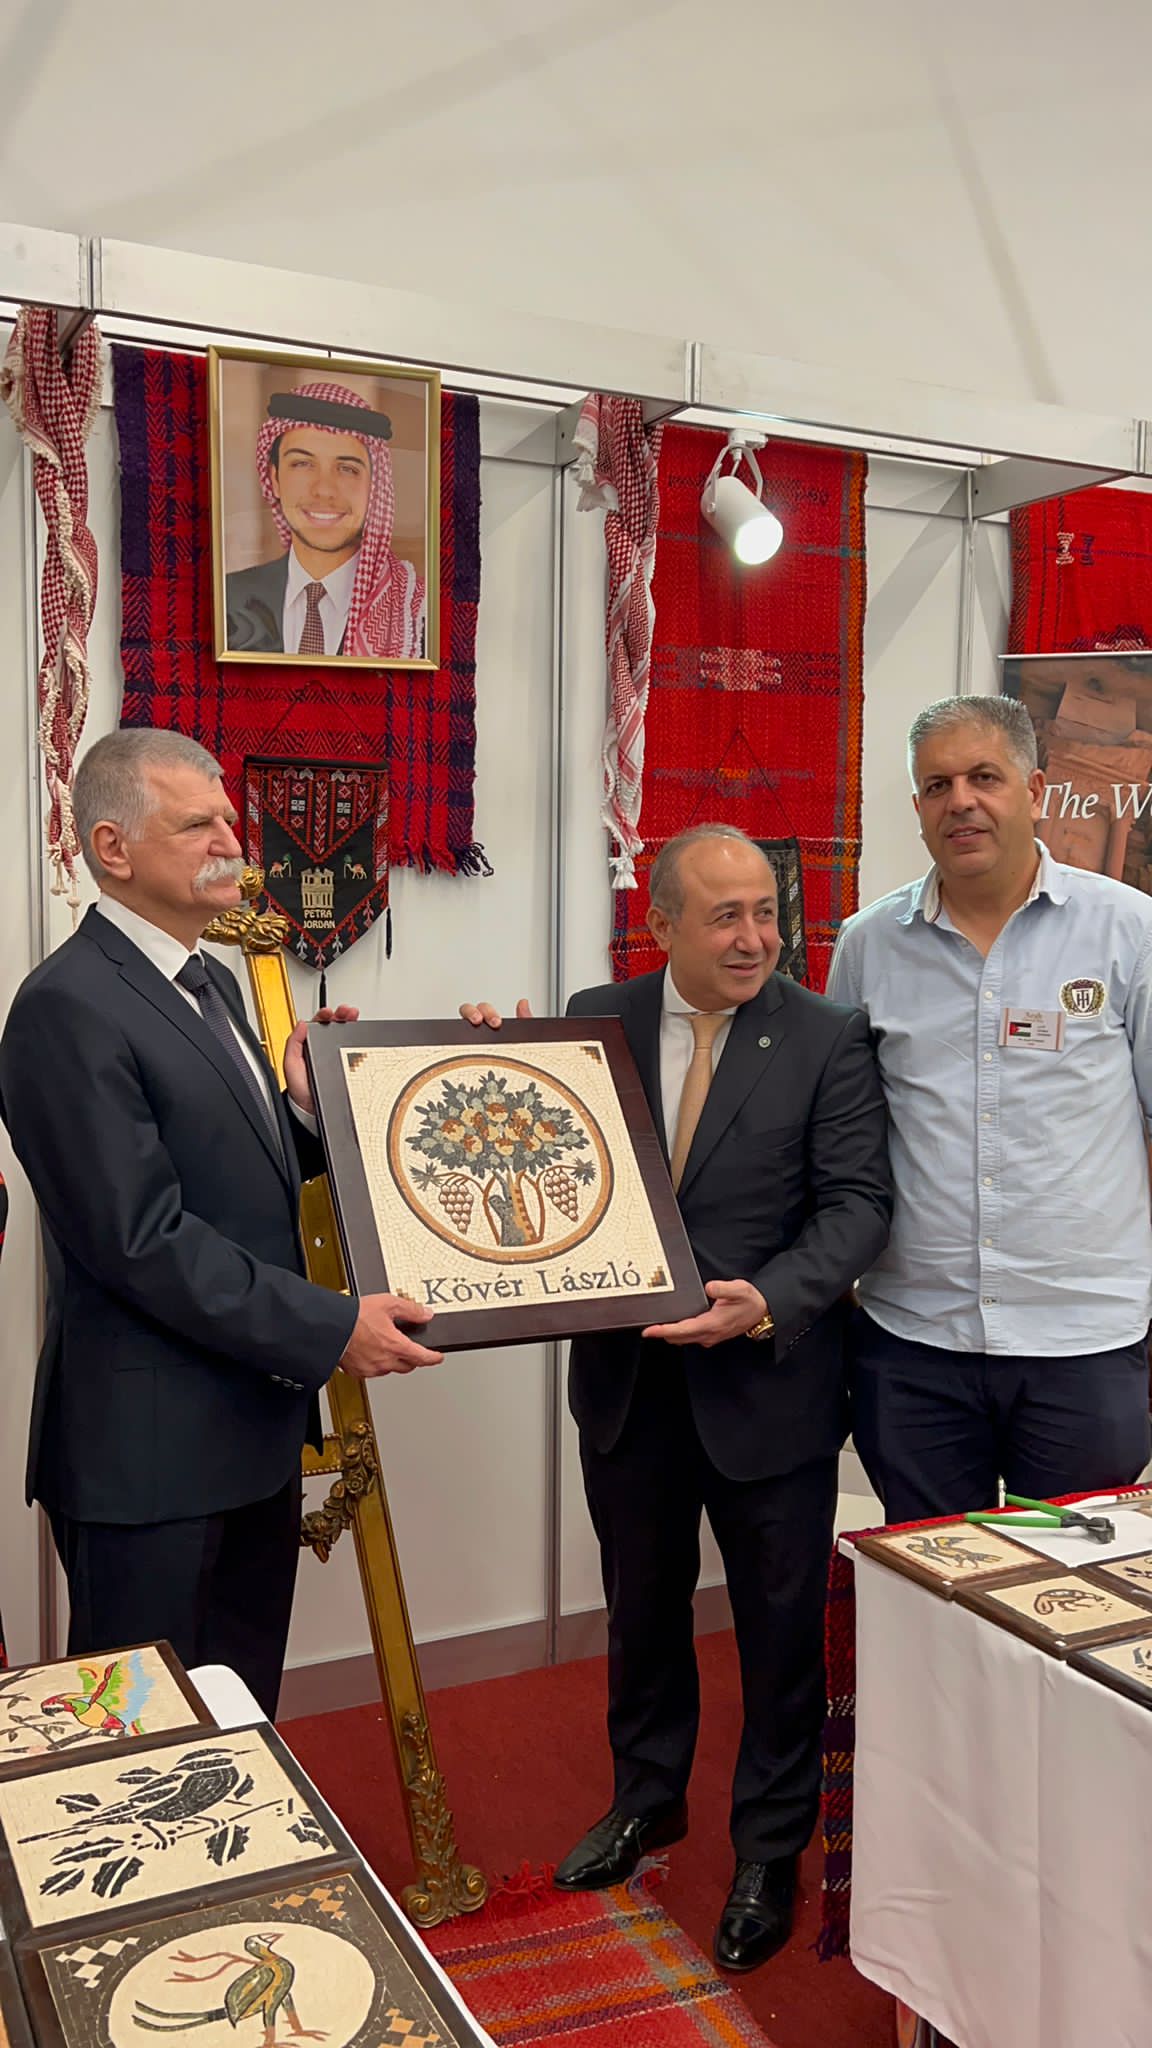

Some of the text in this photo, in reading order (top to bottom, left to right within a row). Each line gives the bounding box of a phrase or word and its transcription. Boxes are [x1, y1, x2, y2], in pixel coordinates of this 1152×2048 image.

[1040, 781, 1152, 819] The W
[303, 919, 336, 929] JORDAN
[304, 909, 333, 919] PETRA
[422, 1261, 641, 1305] Kövér László
